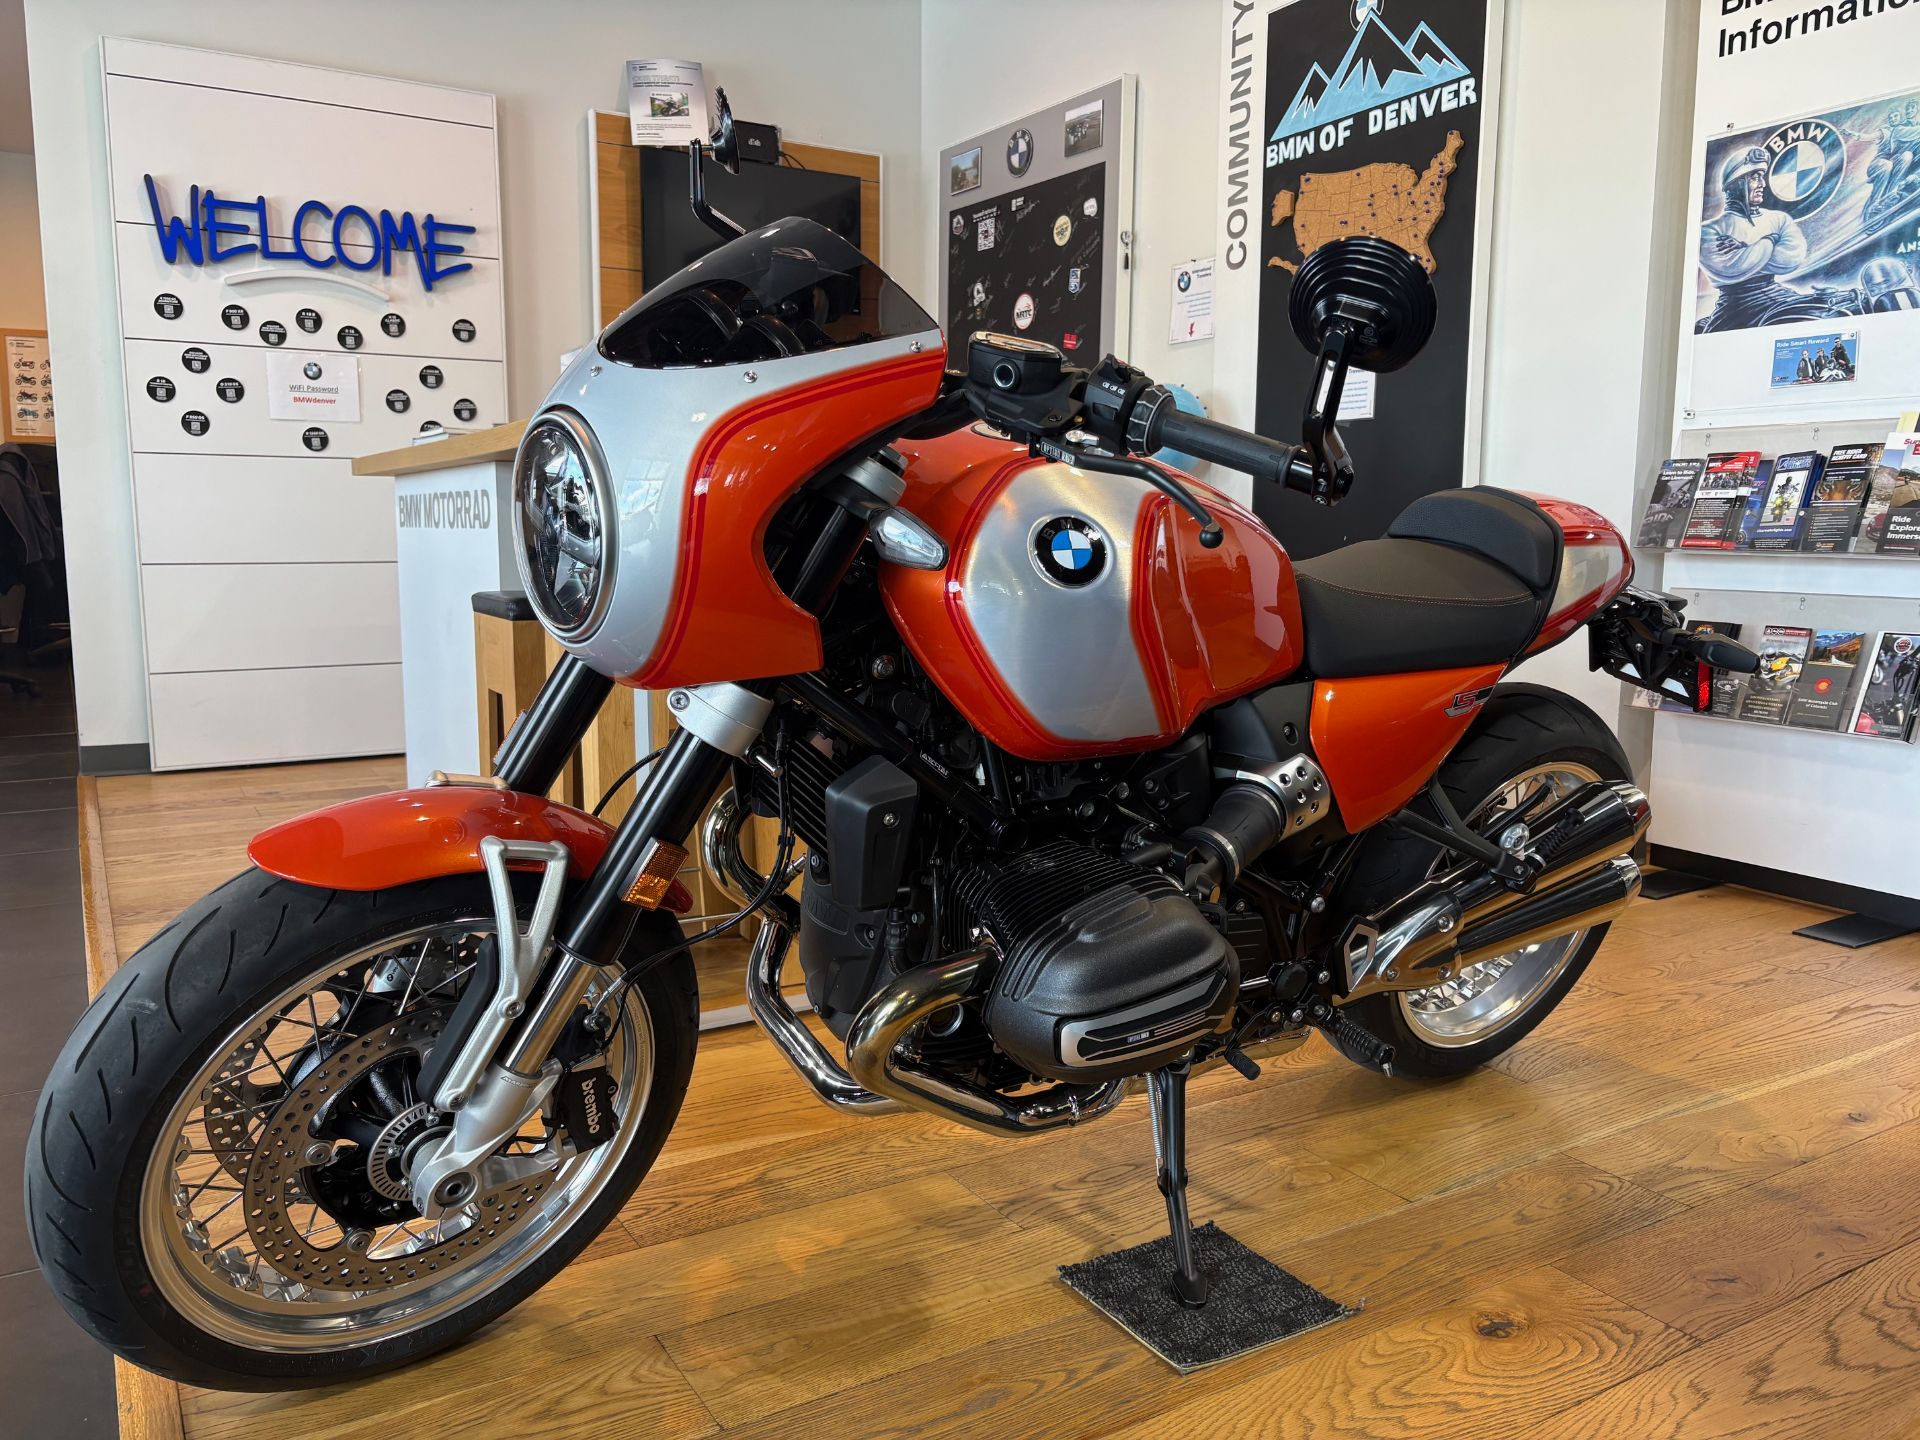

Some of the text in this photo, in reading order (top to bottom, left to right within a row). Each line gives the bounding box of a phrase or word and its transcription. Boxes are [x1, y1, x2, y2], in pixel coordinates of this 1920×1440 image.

[1225, 0, 1255, 271] COMMUNITY
[1266, 77, 1477, 169] BMW OF DENVER
[1769, 123, 1829, 153] BMW
[143, 173, 476, 292] WELCOME
[289, 384, 339, 393] WiFi Password
[293, 396, 336, 404] BMWdenver
[398, 489, 491, 529] BMW MOTORRAD
[1891, 515, 1911, 523] Ride
[581, 1077, 602, 1134] brembo
